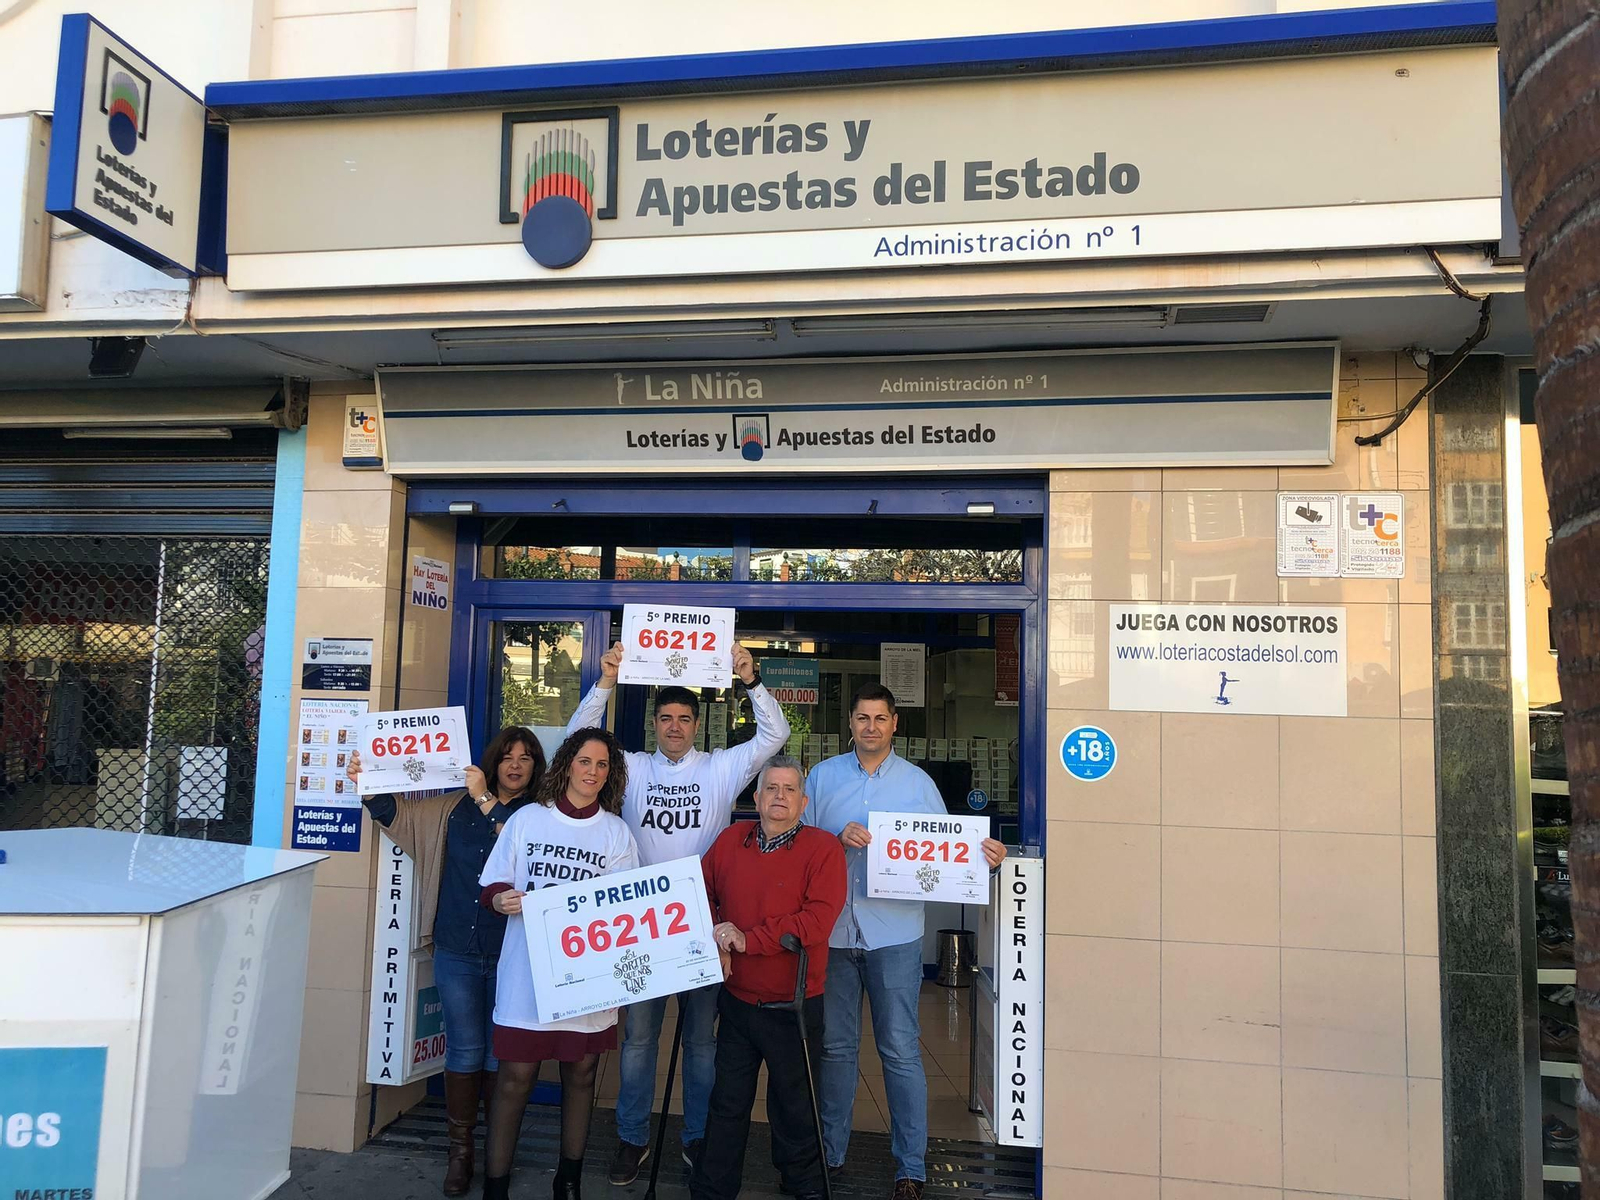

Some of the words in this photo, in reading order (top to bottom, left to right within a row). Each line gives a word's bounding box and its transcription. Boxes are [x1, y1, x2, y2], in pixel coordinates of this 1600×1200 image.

[636, 113, 828, 161] Loterías
[843, 118, 871, 160] y
[94, 167, 154, 215] Apuestas
[155, 204, 174, 227] del
[149, 181, 158, 199] y
[635, 169, 858, 227] Apuestas
[872, 160, 947, 207] del
[963, 151, 1141, 202] Estado
[93, 187, 139, 226] Estado
[873, 227, 1072, 258] Administración
[1087, 225, 1114, 249] nº
[1131, 225, 1141, 247] 1
[645, 374, 678, 401] La
[691, 371, 764, 400] Niña
[880, 375, 1008, 395] Administración
[1014, 375, 1033, 391] nº
[1040, 375, 1048, 389] 1
[626, 427, 710, 449] Loterías
[715, 430, 727, 452] y
[777, 426, 875, 451] Apuestas
[881, 425, 914, 446] del
[921, 424, 996, 445] Estado
[412, 590, 447, 609] NIÑO
[664, 612, 711, 625] PREMIO
[1116, 613, 1180, 631] JUEGA
[1185, 614, 1226, 632] CON
[1232, 615, 1339, 634] NOSOTROS
[638, 629, 717, 652] 66212
[1116, 642, 1339, 664] www.loteriacostadelsol.com
[766, 667, 814, 676] EuroMillones
[393, 715, 441, 729] PREMIO
[371, 732, 451, 757] 66212
[1103, 741, 1111, 762] AÑOS
[657, 783, 701, 796] PREMIO
[646, 795, 702, 809] VENDIDO
[298, 809, 335, 820] Loterías
[336, 813, 343, 823] y
[640, 805, 702, 835] AQUÍ
[297, 834, 328, 845] Estado
[298, 822, 340, 833] Apuestas
[342, 823, 357, 834] del
[912, 821, 963, 835] PREMIO
[542, 844, 607, 870] PREMIO
[886, 838, 969, 864] 66212
[594, 875, 671, 908] PREMIO
[560, 901, 691, 959] 66212
[1012, 864, 1028, 982] LOTERIA
[613, 953, 651, 979] SORTEO
[380, 947, 399, 1080] PRIMITIVA
[581, 1004, 603, 1013] ARROYO
[1011, 1002, 1027, 1140] NACIONAL
[15, 1188, 94, 1200] MARTES
